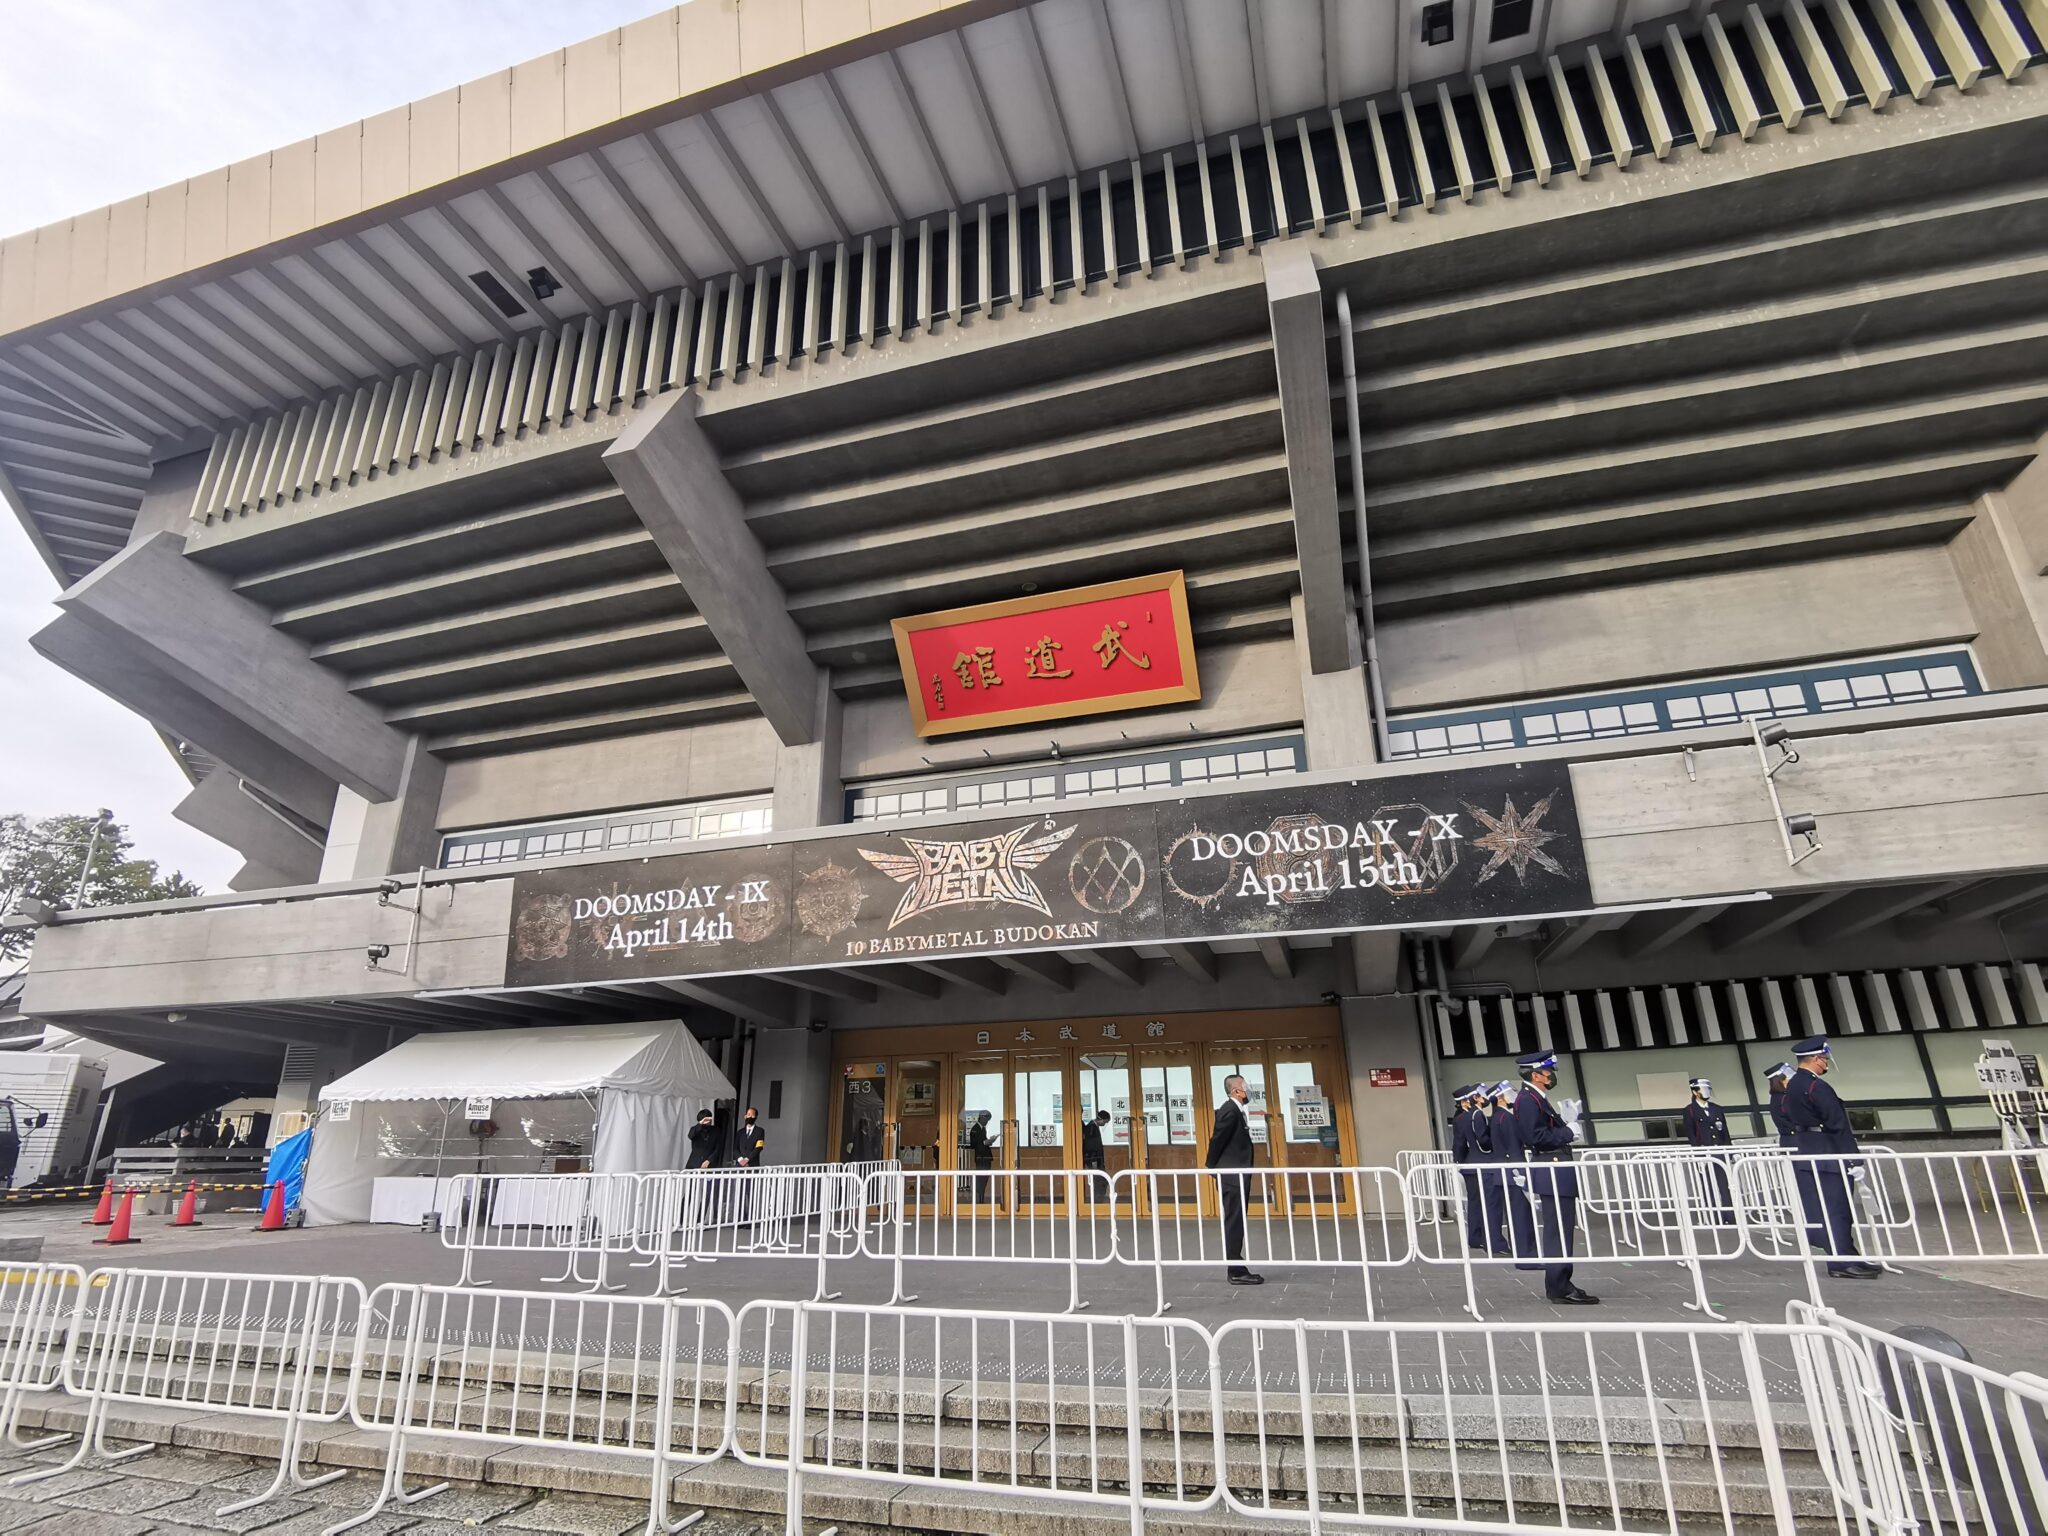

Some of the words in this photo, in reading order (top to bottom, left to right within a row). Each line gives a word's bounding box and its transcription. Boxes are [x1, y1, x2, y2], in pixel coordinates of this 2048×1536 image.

[952, 620, 1150, 689] 武道館
[912, 830, 1024, 876] BABY
[1190, 819, 1399, 861] DOOMSDAY
[1429, 813, 1464, 841] X
[574, 885, 721, 919] DOOMSDAY
[741, 880, 770, 903] IX
[1236, 859, 1329, 905] April
[1338, 852, 1422, 889] 15th
[604, 917, 670, 957] April
[677, 912, 734, 943] 14th
[845, 941, 863, 957] 10
[869, 931, 988, 954] BABYMETAL
[993, 921, 1099, 945] BUDOKAN
[977, 1022, 1165, 1044] 日本武道館
[468, 1103, 489, 1111] Amuse
[1117, 1100, 1125, 1108] 北
